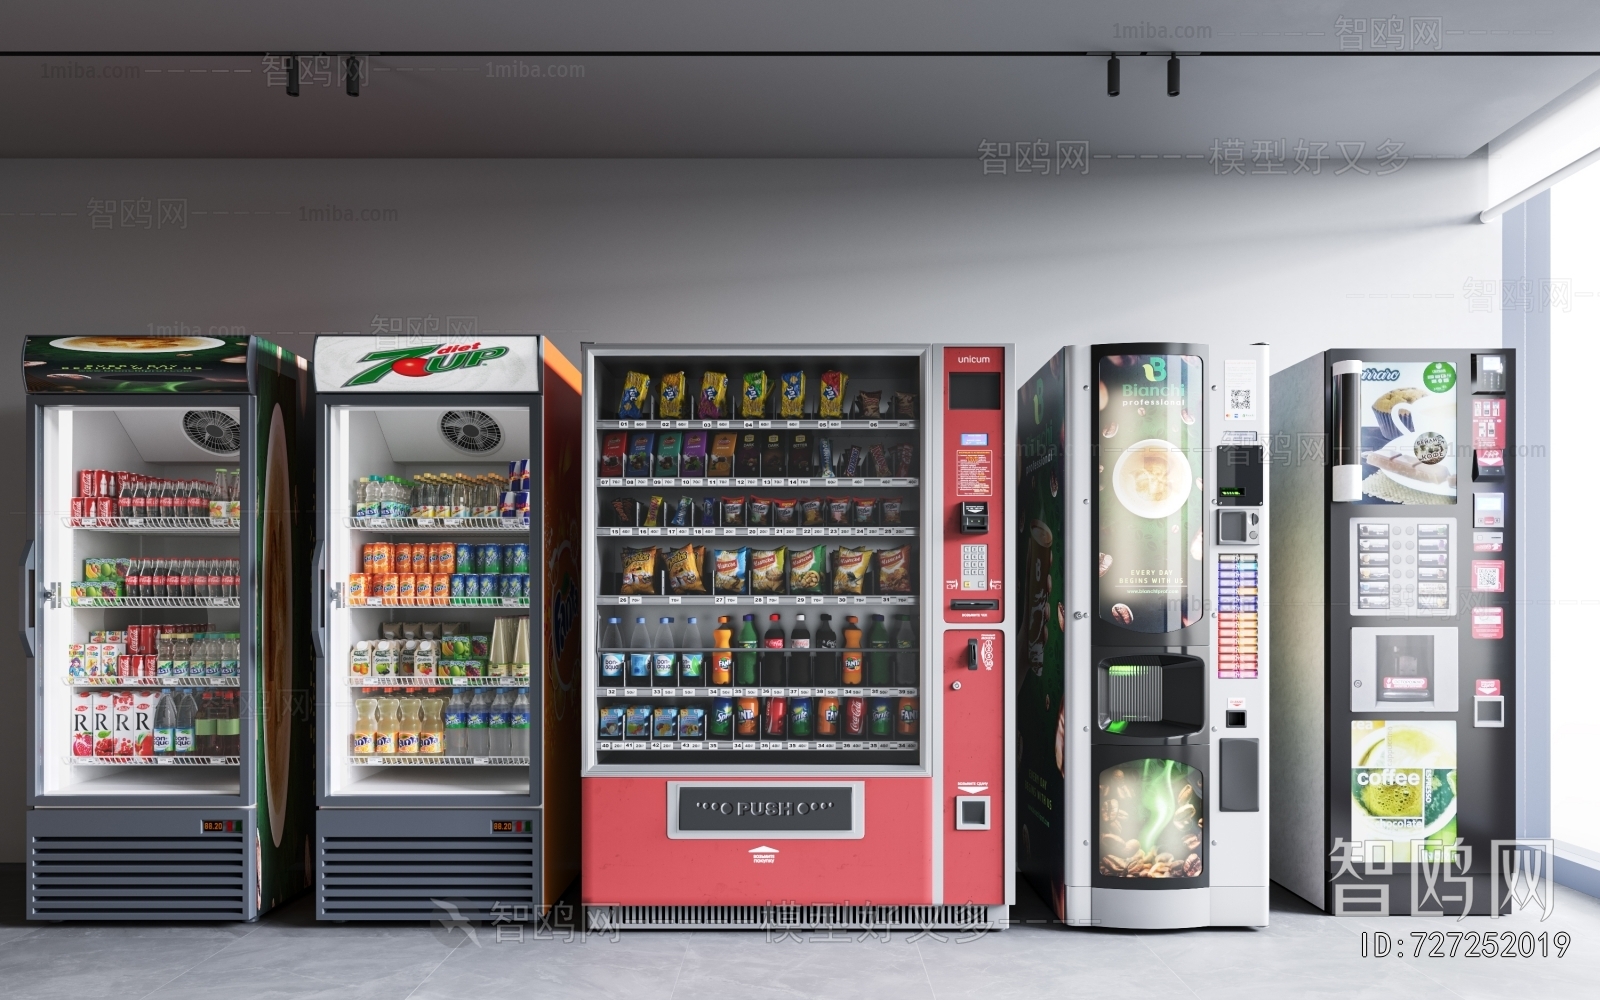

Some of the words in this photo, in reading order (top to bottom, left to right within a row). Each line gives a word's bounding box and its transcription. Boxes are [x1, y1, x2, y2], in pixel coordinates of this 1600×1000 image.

[437, 342, 480, 354] diet
[958, 356, 990, 364] unicum
[1361, 368, 1400, 382] arraro
[1122, 384, 1185, 397] Bianchi
[1122, 399, 1185, 407] professional
[1421, 452, 1444, 460] КОФЕ
[74, 714, 88, 731] R
[95, 713, 108, 730] R
[116, 714, 130, 731] R
[136, 712, 150, 730] R
[850, 700, 862, 732] Coca-Cola
[1357, 769, 1420, 786] coffee
[737, 802, 794, 816] PUSH
[204, 822, 223, 830] 88.20
[493, 822, 512, 830] 88.20
[1376, 818, 1423, 828] chocolate
